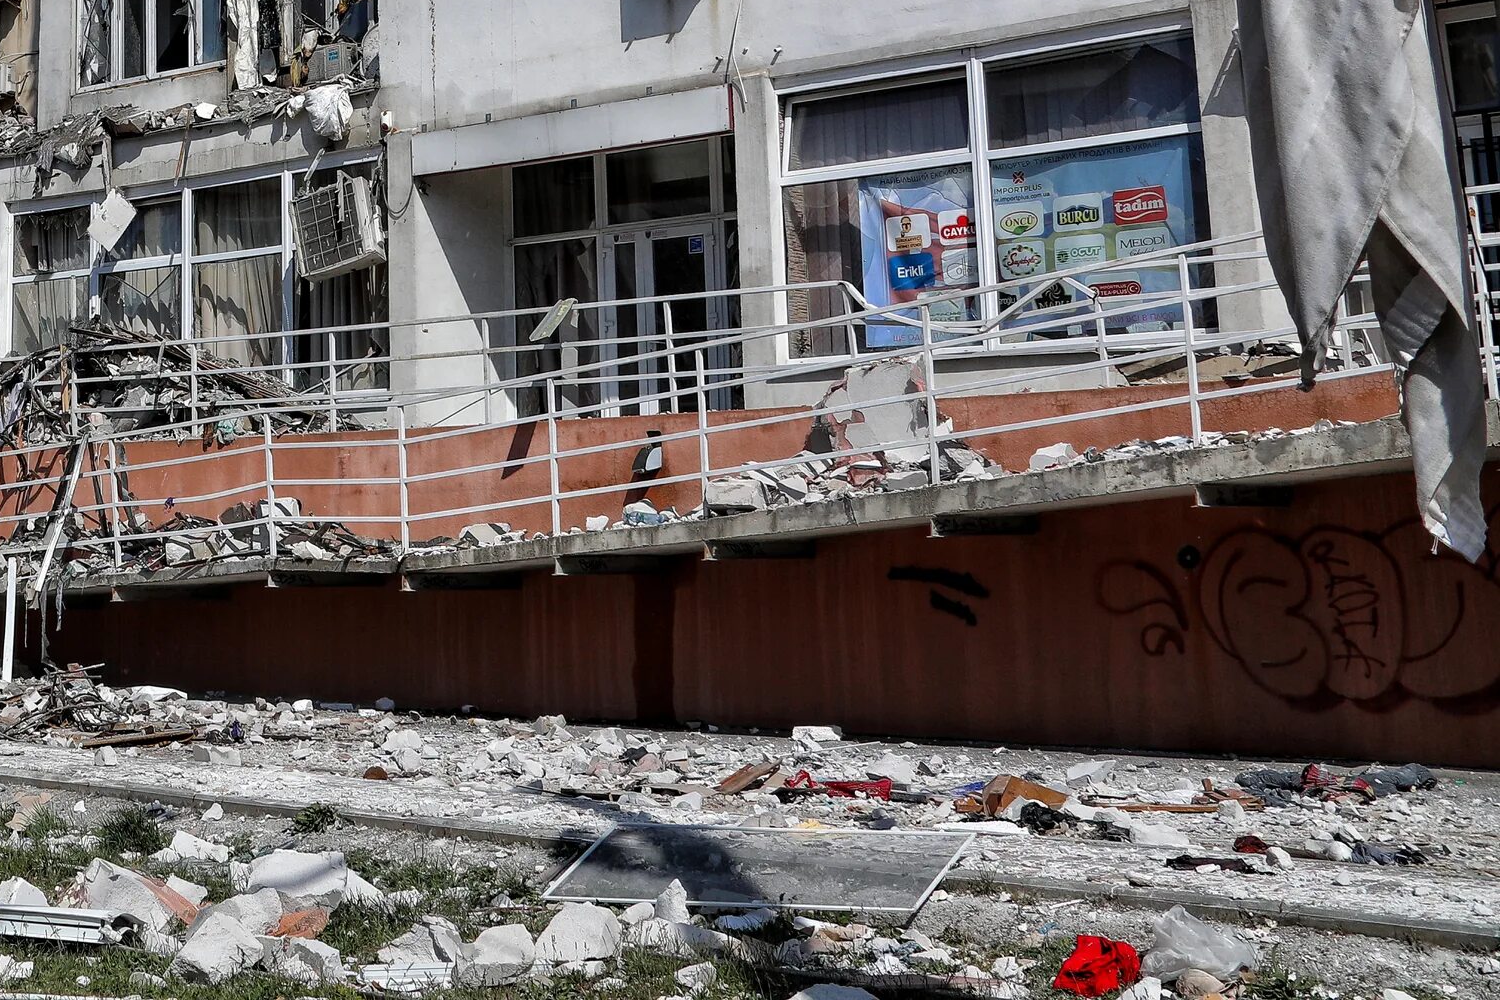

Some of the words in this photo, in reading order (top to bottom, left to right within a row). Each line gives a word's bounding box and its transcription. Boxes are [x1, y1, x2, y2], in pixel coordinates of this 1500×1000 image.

[1034, 151, 1077, 164] ТУРЕЦЬКИХ
[1079, 146, 1124, 158] ПРОДУКТІВ
[994, 184, 1042, 194] IMPORTPLUS
[1059, 209, 1099, 225] BURCU
[897, 265, 924, 278] Erikli
[1100, 288, 1128, 296] TEA-PLUS
